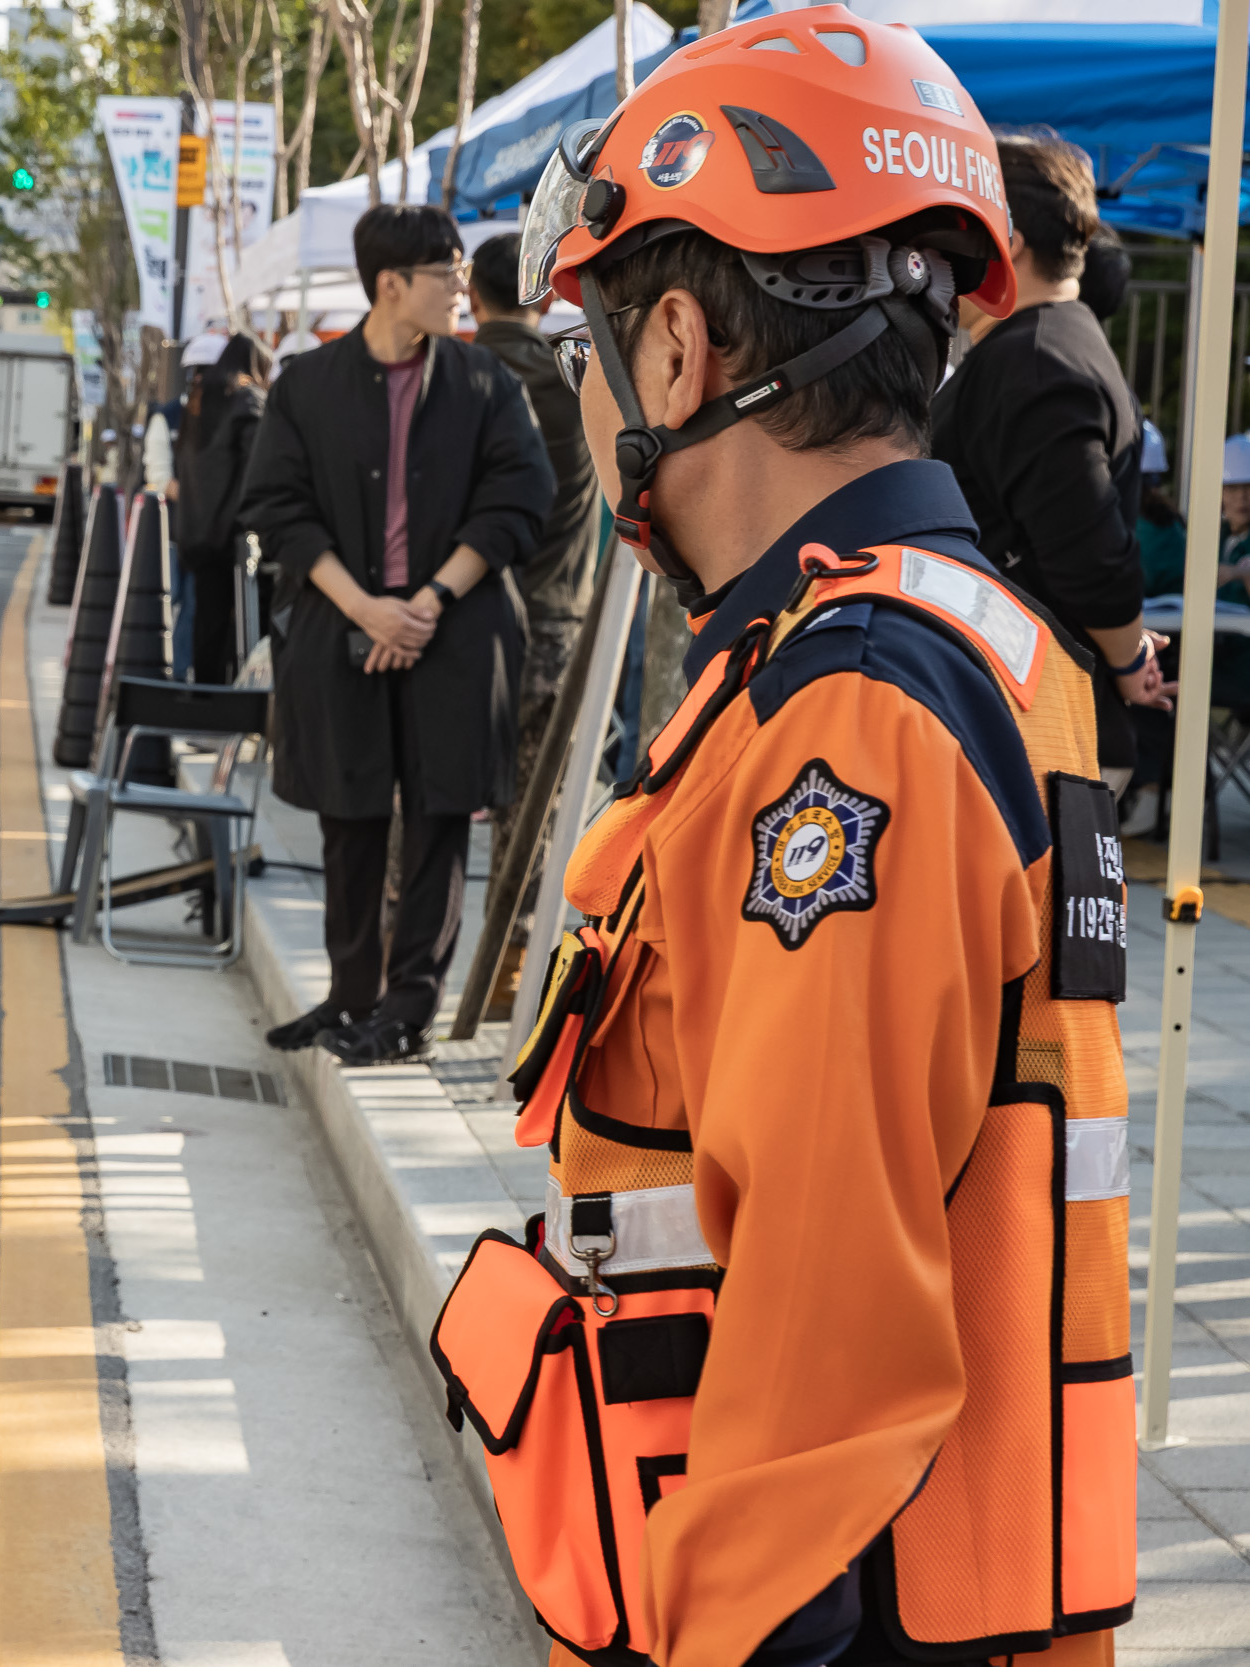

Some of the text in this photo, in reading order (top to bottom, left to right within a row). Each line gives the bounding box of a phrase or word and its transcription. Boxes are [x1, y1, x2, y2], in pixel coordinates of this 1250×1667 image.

[862, 127, 1003, 210] SEOUL FIRE
[786, 835, 826, 867] 119
